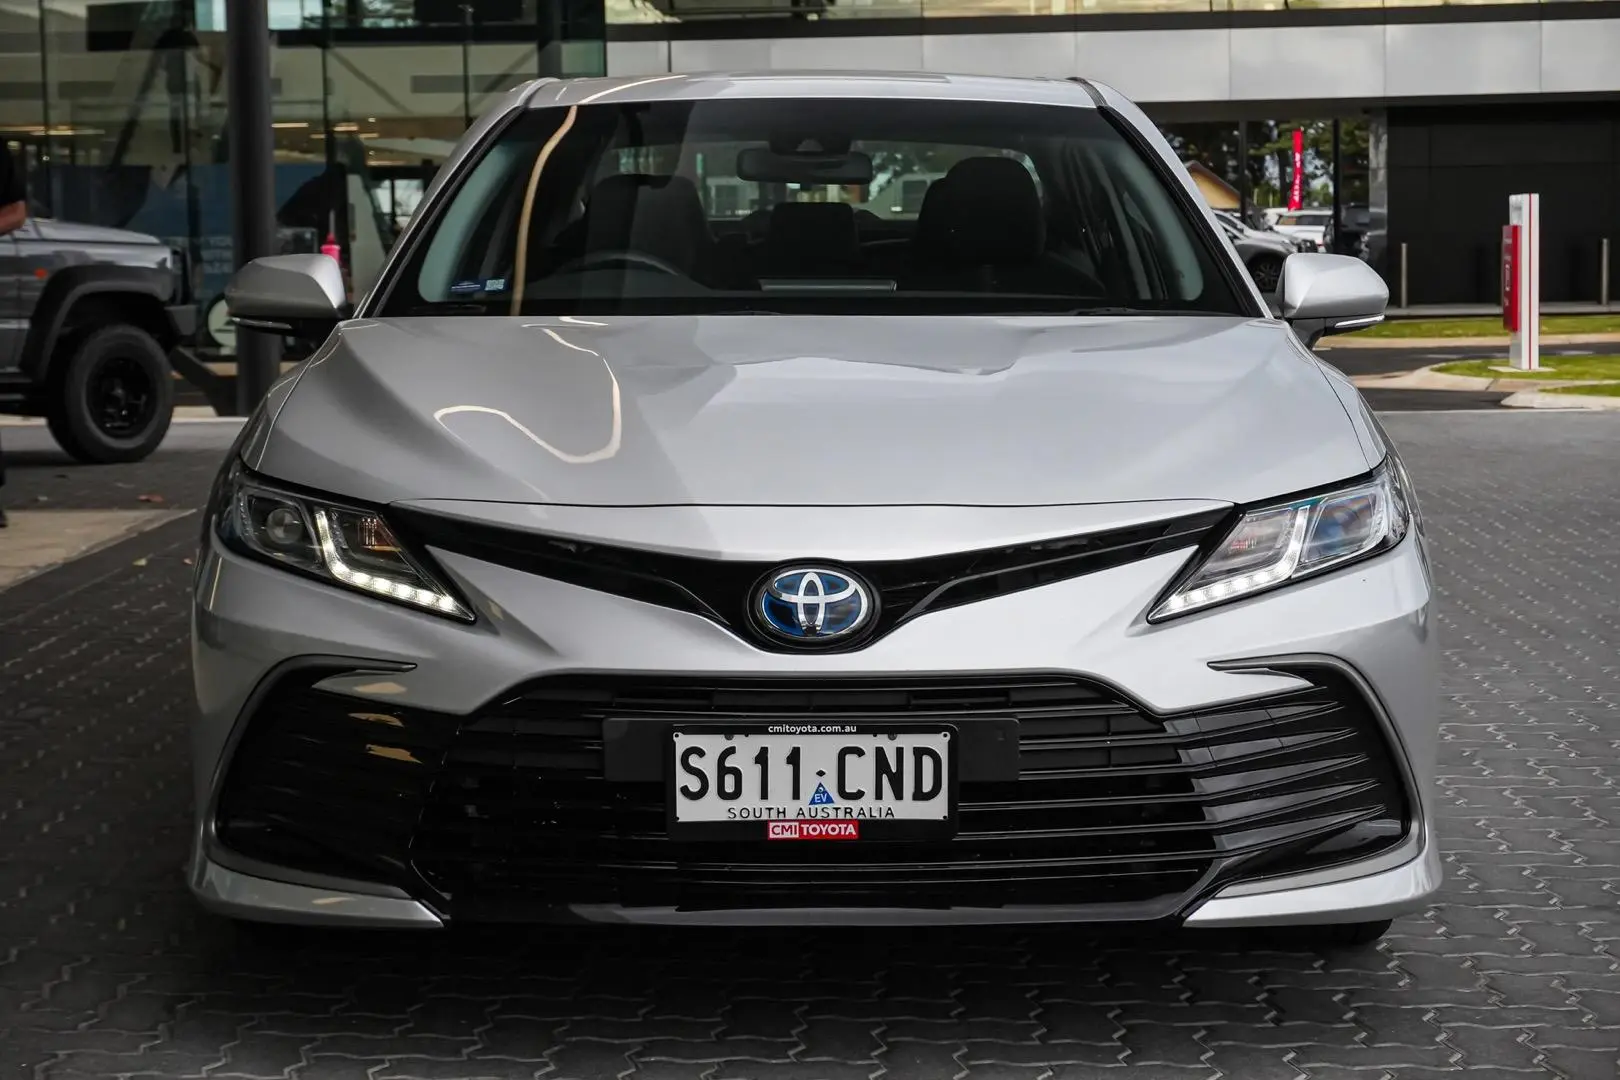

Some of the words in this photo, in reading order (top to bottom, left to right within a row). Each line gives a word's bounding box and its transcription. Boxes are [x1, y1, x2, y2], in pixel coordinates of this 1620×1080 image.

[767, 723, 857, 734] cmitoyota.com.au
[814, 793, 828, 803] EV
[727, 807, 787, 819] SOUTH
[796, 806, 895, 819] AUSTRALIA
[770, 824, 798, 836] CMI
[801, 824, 857, 836] TOYOTA
